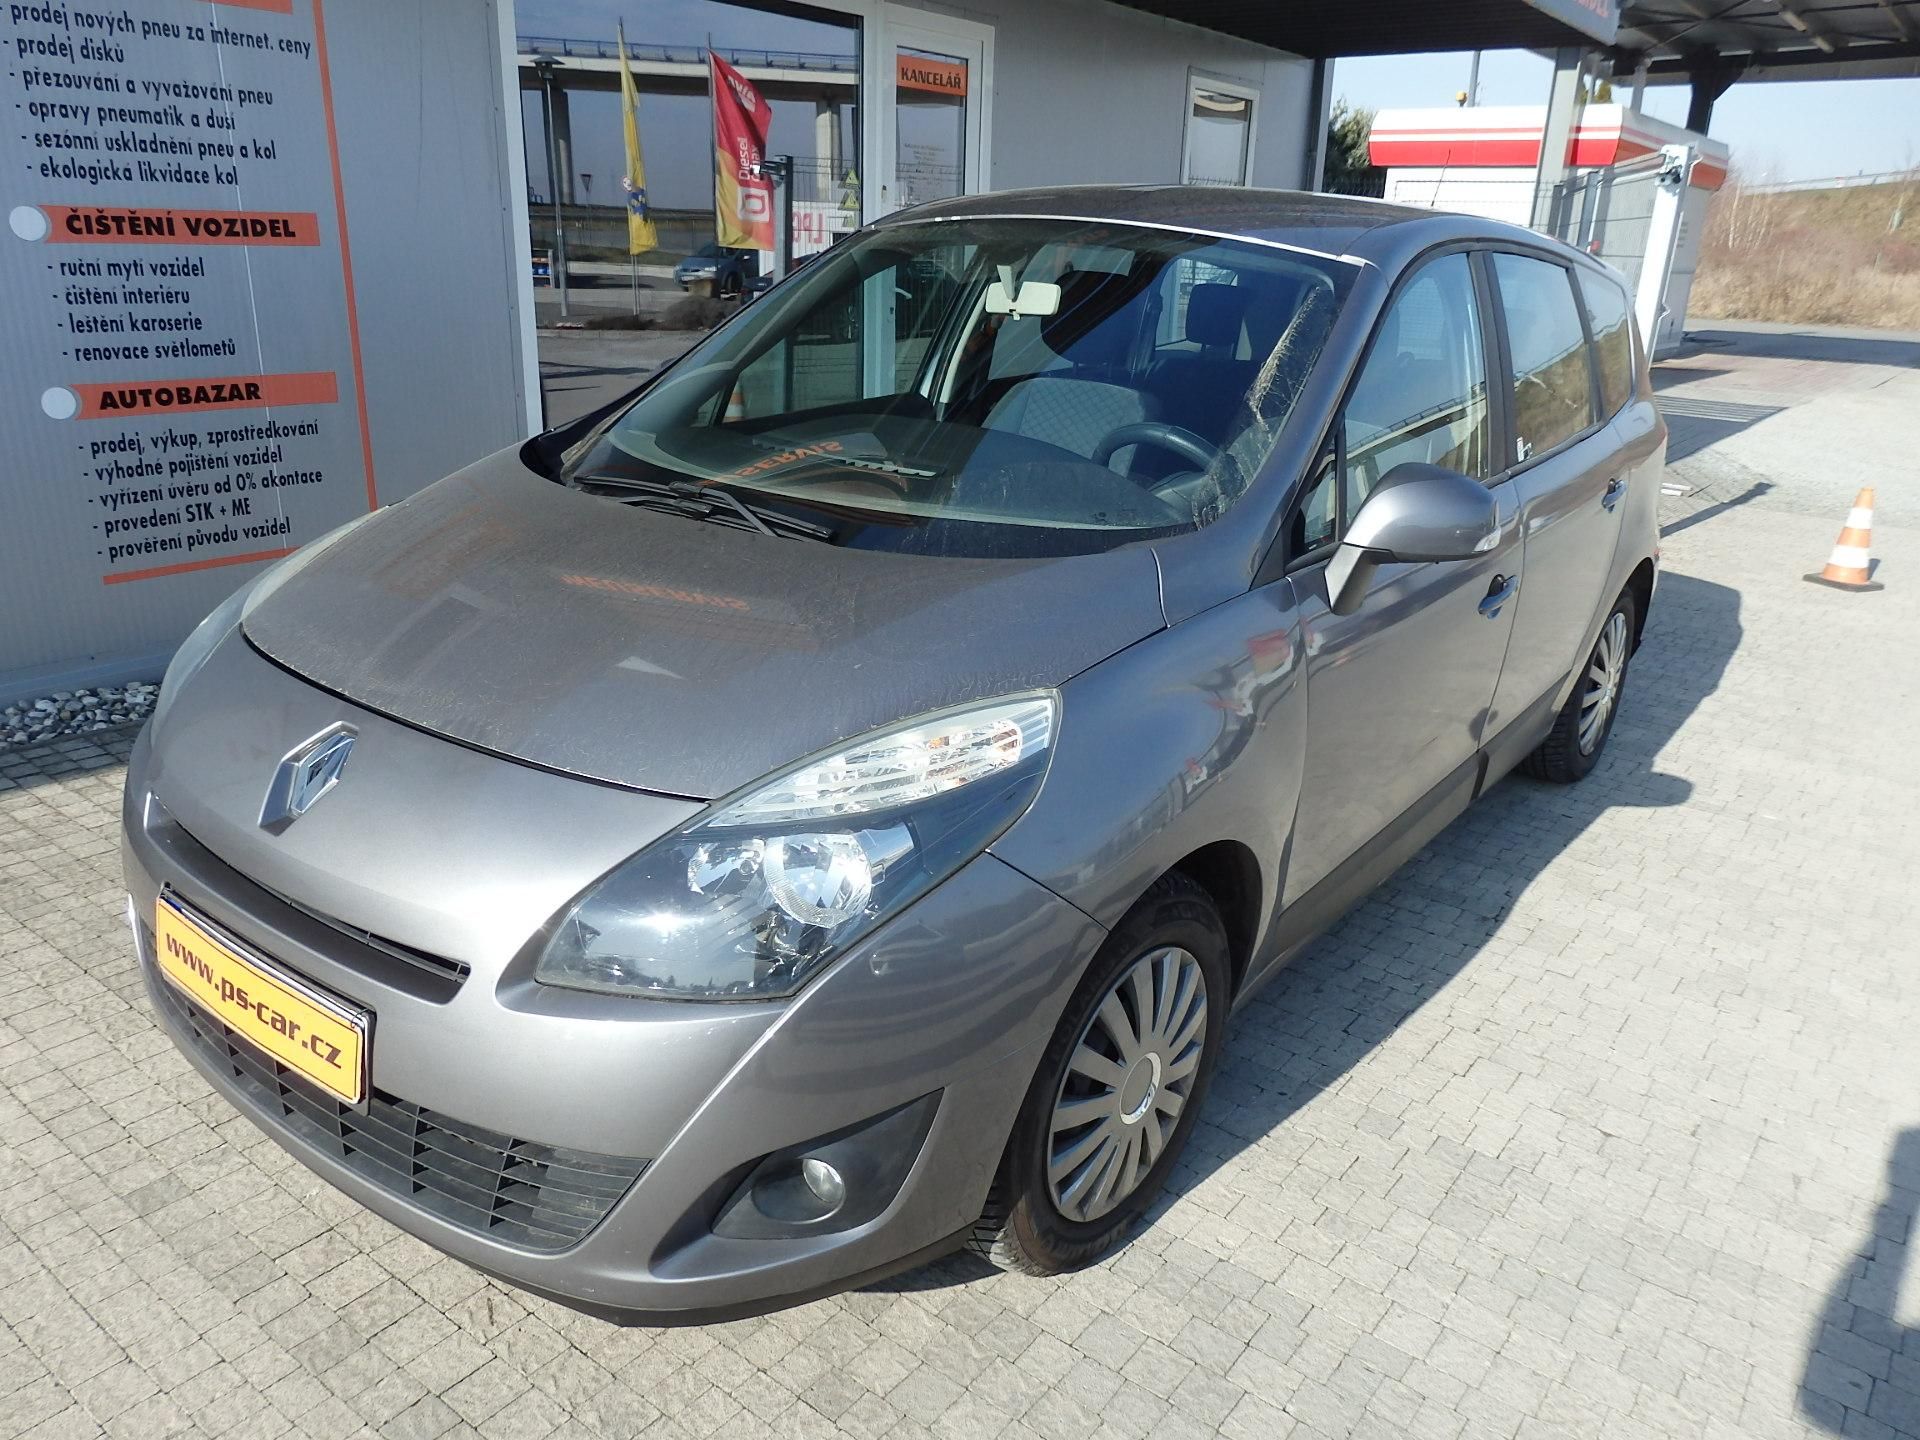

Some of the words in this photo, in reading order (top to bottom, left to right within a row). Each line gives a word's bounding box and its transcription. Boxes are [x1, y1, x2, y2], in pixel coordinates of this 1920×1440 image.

[10, 1, 69, 31] prodej
[74, 10, 136, 36] nových
[142, 20, 180, 40] pneu
[186, 25, 205, 41] za
[279, 38, 311, 59] ceny
[17, 34, 75, 64] prodej
[80, 37, 125, 63] disků
[23, 67, 120, 91] přezouvání
[126, 79, 136, 93] a
[142, 80, 234, 101] vyvažování
[237, 89, 273, 107] pneu
[901, 67, 962, 90] KANCELÁŘ
[29, 102, 90, 126] opravy
[97, 105, 185, 127] pneumatik
[191, 113, 200, 127] a
[35, 129, 99, 151] sezónní
[104, 131, 193, 155] uskladnění
[197, 142, 234, 160] pneu
[239, 145, 248, 158] a
[253, 139, 277, 160] kol
[738, 137, 750, 181] Diesel
[40, 156, 133, 185] ekologická
[138, 161, 209, 184] likvidace
[214, 164, 239, 186] kol
[66, 208, 176, 236] ČIŠTĚNÍ
[183, 217, 296, 238] VOZIDEL
[60, 257, 102, 277] ruční
[149, 256, 205, 277] vozidel
[65, 284, 118, 305] čištění
[122, 284, 190, 304] interiéru
[69, 313, 125, 333] leštění
[129, 311, 203, 332] karoserie
[75, 344, 149, 361] renovace
[155, 337, 236, 359] světlometů
[100, 382, 262, 410] AUTOBAZAR
[90, 432, 145, 460] prodej,
[151, 428, 202, 454] výkup,
[207, 419, 319, 448] zprostředkování
[95, 457, 163, 485] výhodné
[169, 451, 229, 478] pojištění
[234, 444, 283, 467] vozidel
[100, 482, 163, 511] vyřízení
[168, 479, 209, 500] úvěru
[215, 474, 231, 494] od
[236, 471, 257, 491] 0%
[261, 469, 323, 489] akontace
[104, 506, 181, 538] provedení
[185, 501, 215, 523] STK
[232, 497, 251, 517] ME
[108, 532, 182, 563] prověření
[187, 524, 238, 551] původu
[243, 516, 291, 539] vozidel
[165, 932, 343, 1070] www.ps-car.cz
